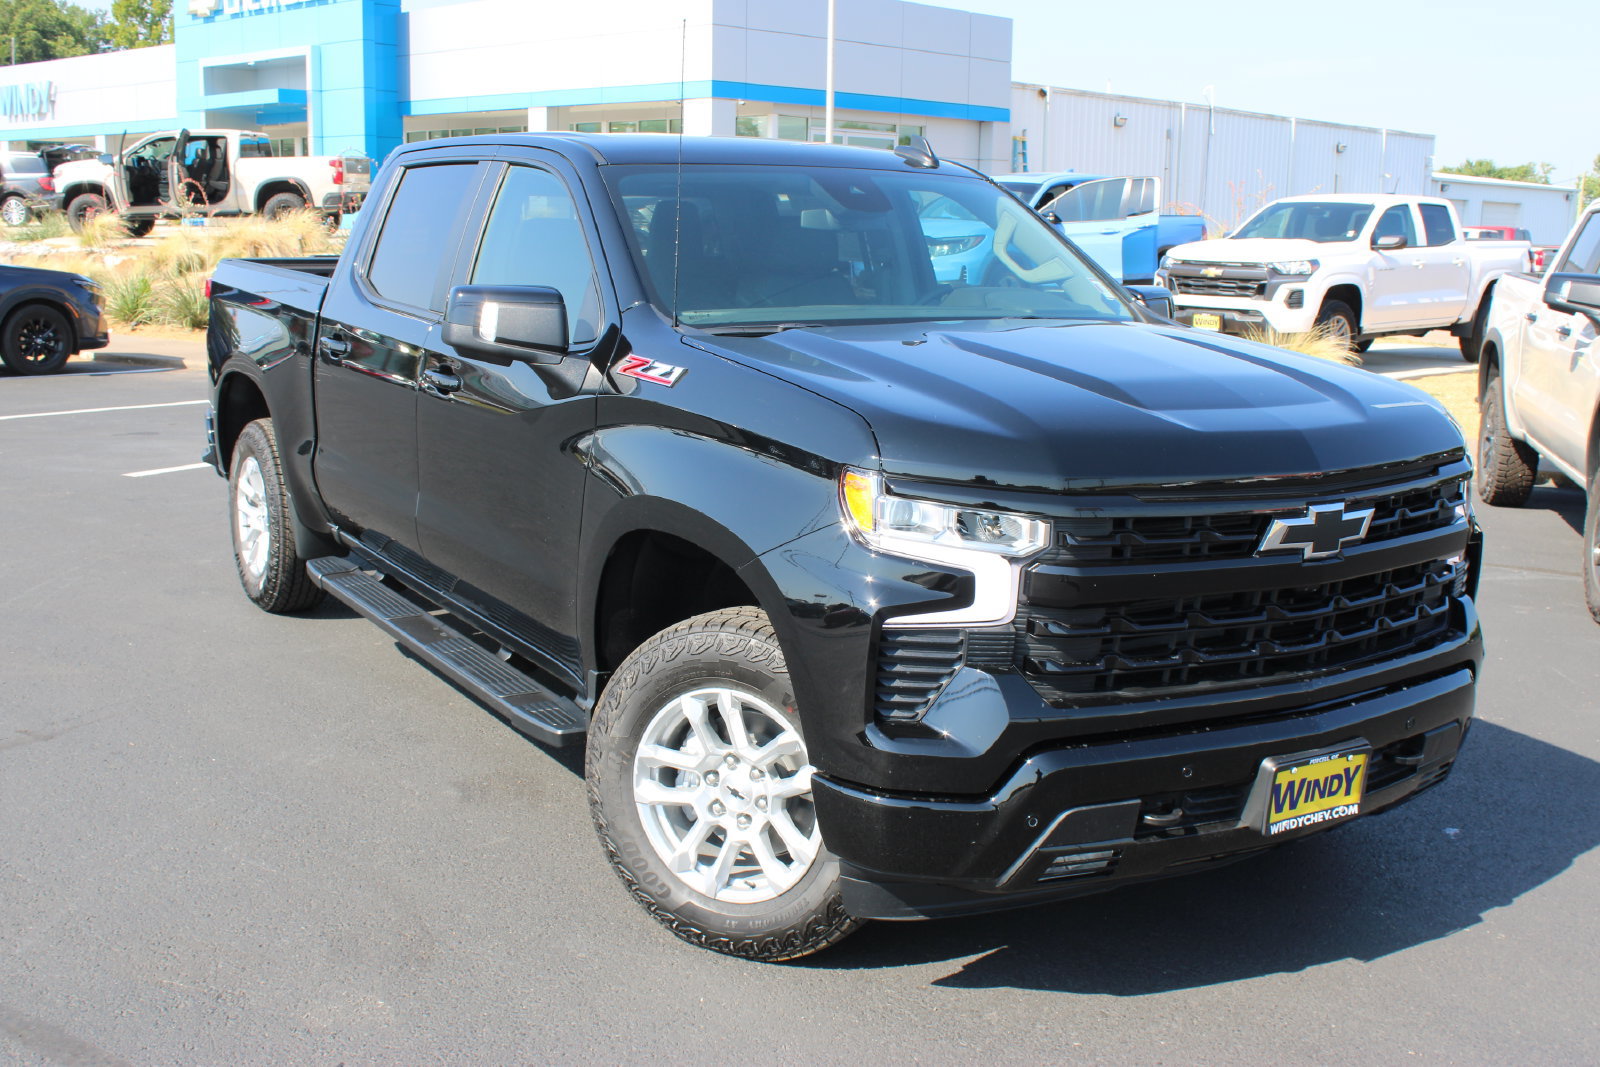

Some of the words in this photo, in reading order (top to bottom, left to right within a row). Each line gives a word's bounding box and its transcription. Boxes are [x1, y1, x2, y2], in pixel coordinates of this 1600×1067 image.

[0, 80, 52, 117] WINDY
[1273, 764, 1362, 814] WINDY
[1270, 804, 1359, 835] WINDYCHEV.COM
